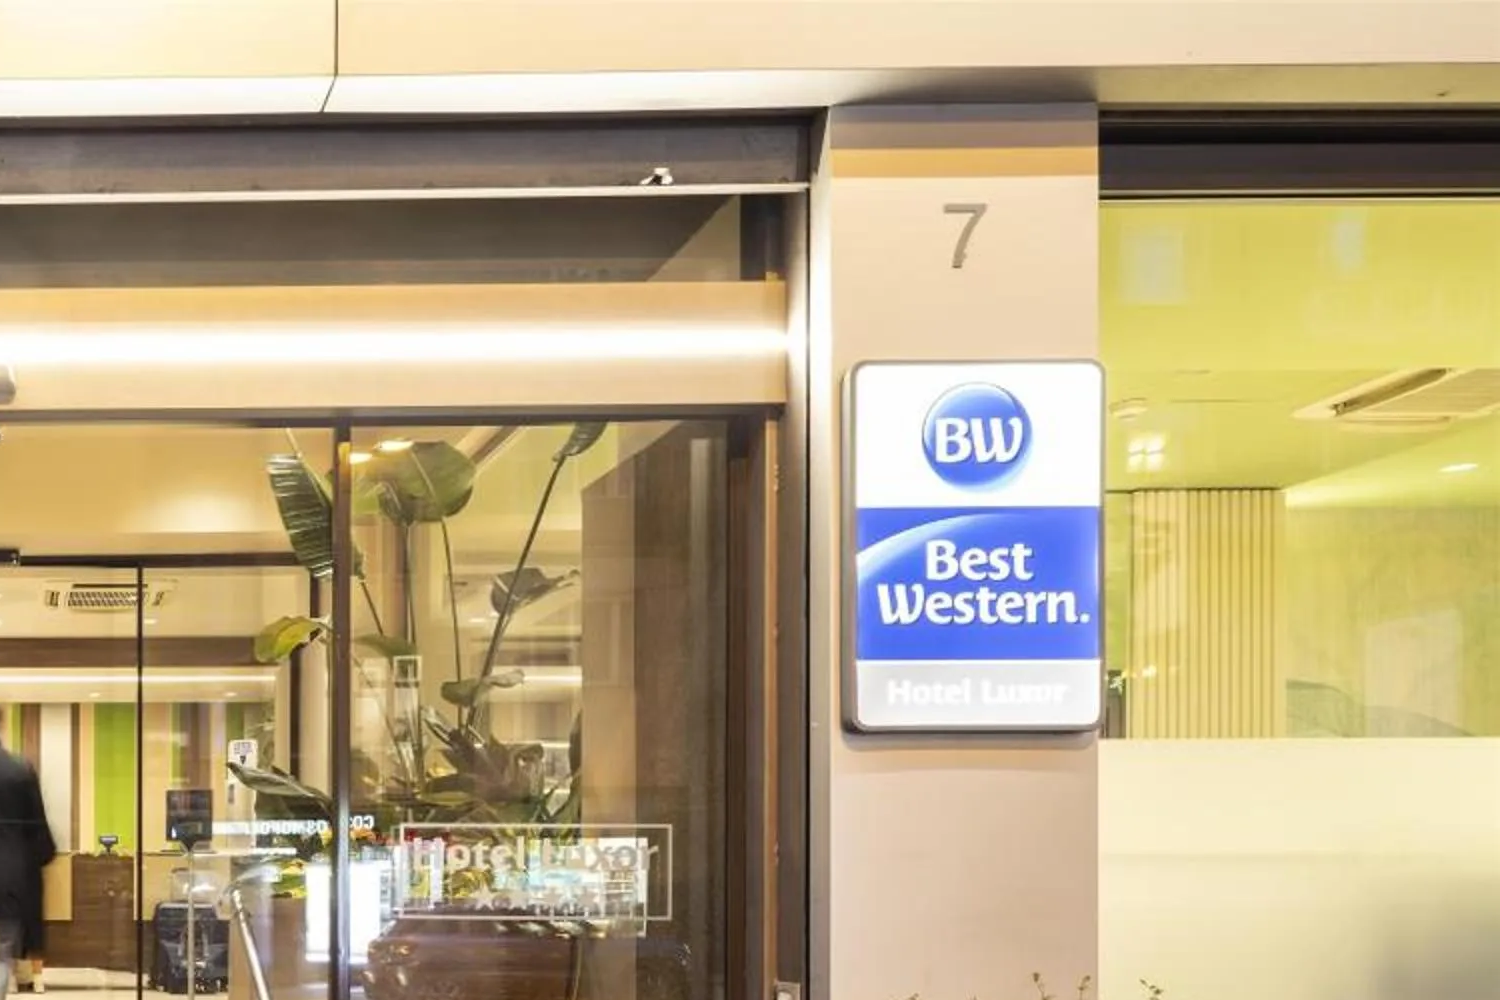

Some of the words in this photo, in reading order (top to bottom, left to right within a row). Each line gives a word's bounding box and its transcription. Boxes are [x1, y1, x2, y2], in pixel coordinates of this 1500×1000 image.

[943, 203, 988, 269] 7
[935, 417, 1024, 464] BW
[925, 539, 1034, 581] Best
[887, 676, 972, 706] Hotel
[980, 677, 1070, 706] Luxor
[413, 836, 526, 871] Hotel
